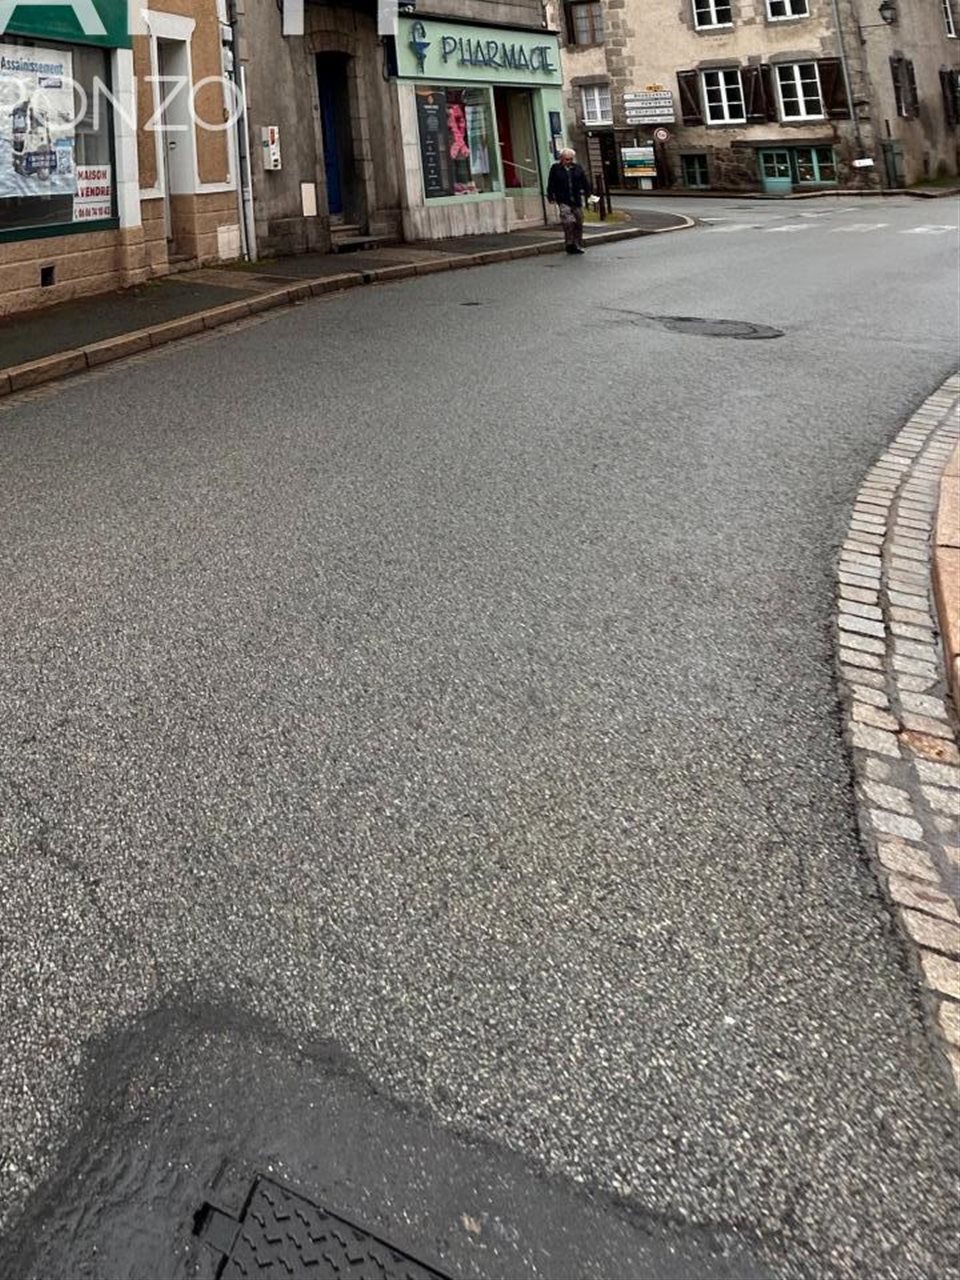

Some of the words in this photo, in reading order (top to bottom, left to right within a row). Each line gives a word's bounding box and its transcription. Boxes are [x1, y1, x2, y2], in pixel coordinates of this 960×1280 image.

[441, 35, 557, 73] PHARMACIE
[0, 56, 63, 75] Assainissement
[77, 169, 107, 180] MAISON
[80, 185, 110, 197] VENDRE
